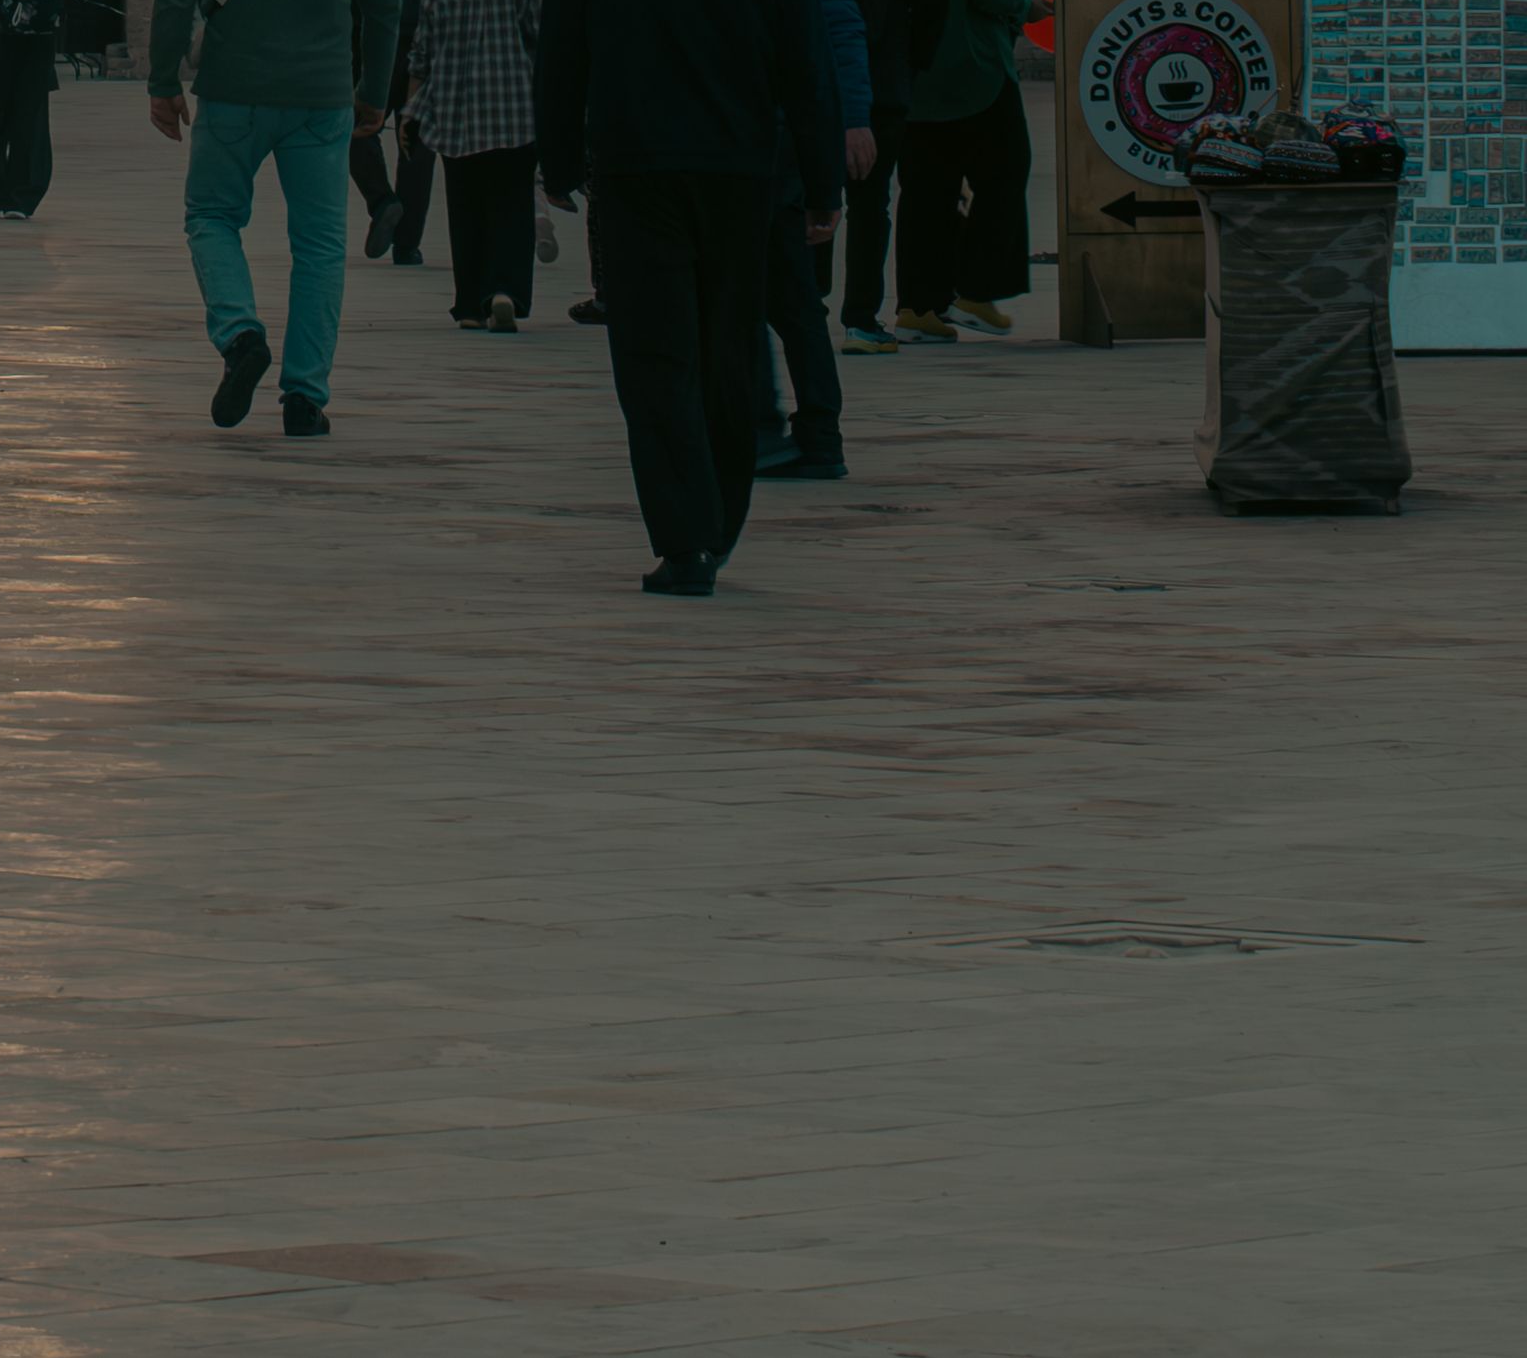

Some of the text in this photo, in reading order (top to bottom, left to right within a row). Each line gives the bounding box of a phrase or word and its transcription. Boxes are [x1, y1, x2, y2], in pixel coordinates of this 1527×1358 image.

[1090, 1, 1270, 102] DONUTS & COFFEE
[1127, 142, 1171, 172] BUK
